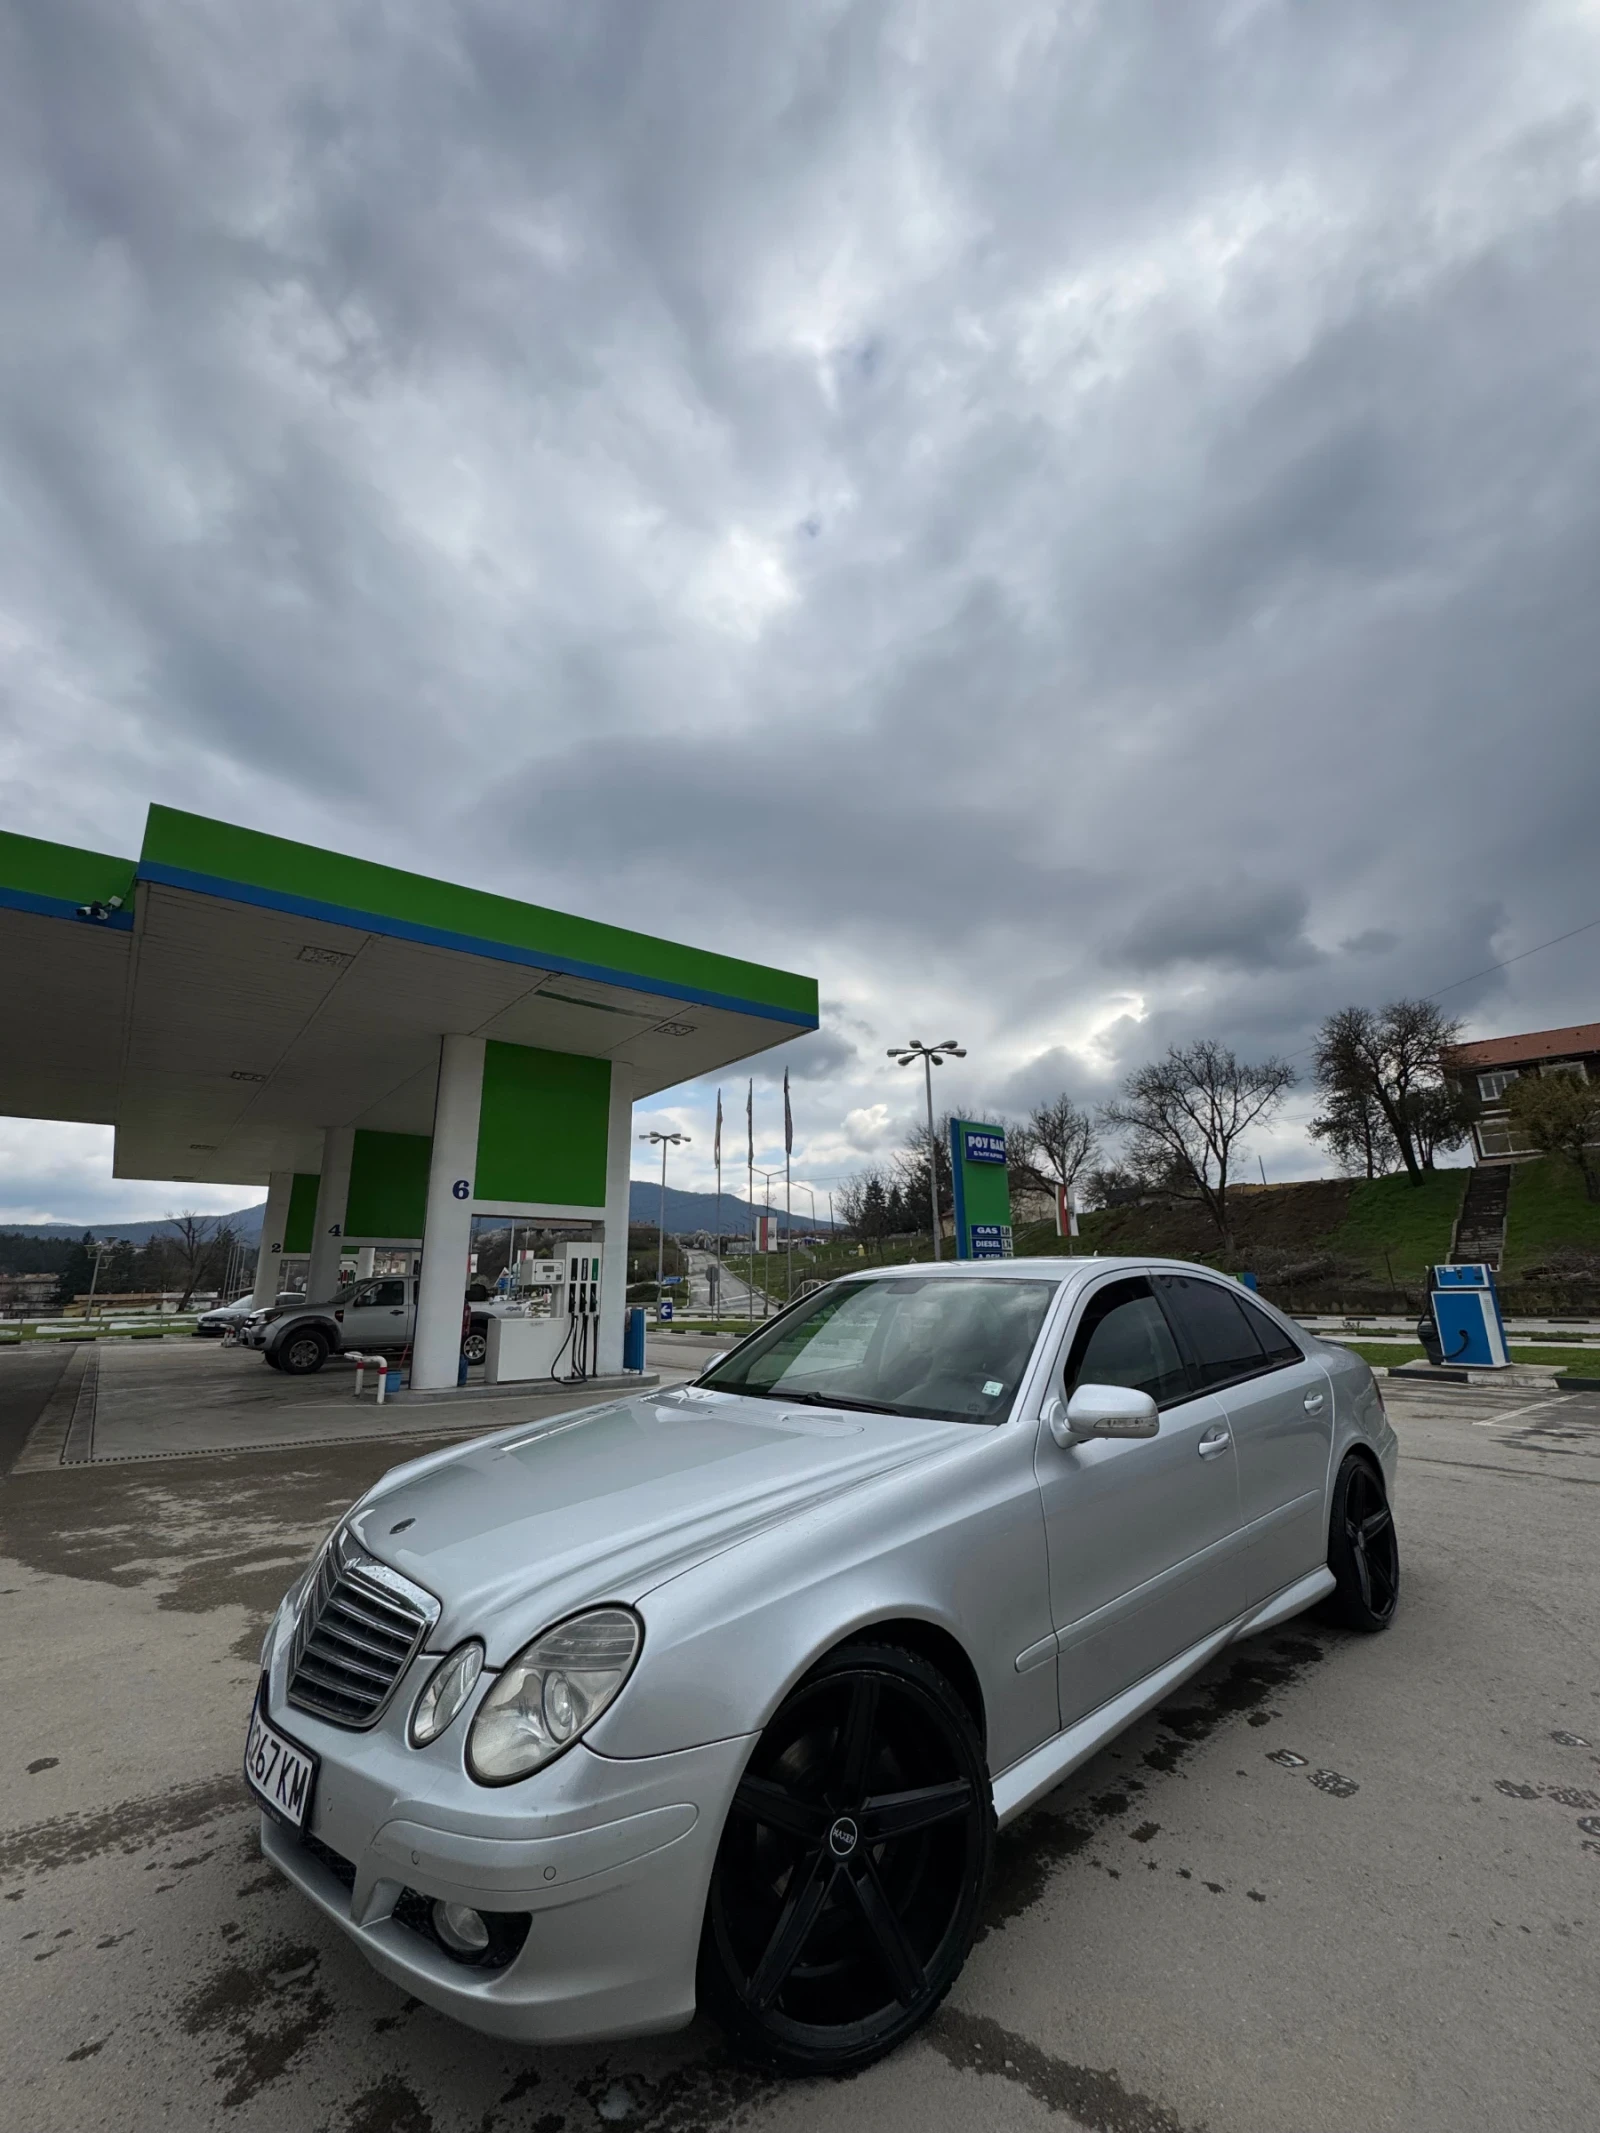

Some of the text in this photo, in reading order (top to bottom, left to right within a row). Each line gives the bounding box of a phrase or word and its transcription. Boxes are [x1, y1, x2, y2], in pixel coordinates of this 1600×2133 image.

[968, 1135, 988, 1148] РОУ
[452, 1179, 470, 1200] 6
[328, 1224, 342, 1237] 4
[977, 1226, 998, 1234] GAS
[271, 1242, 282, 1254] 2
[975, 1240, 1000, 1248] DIESEL
